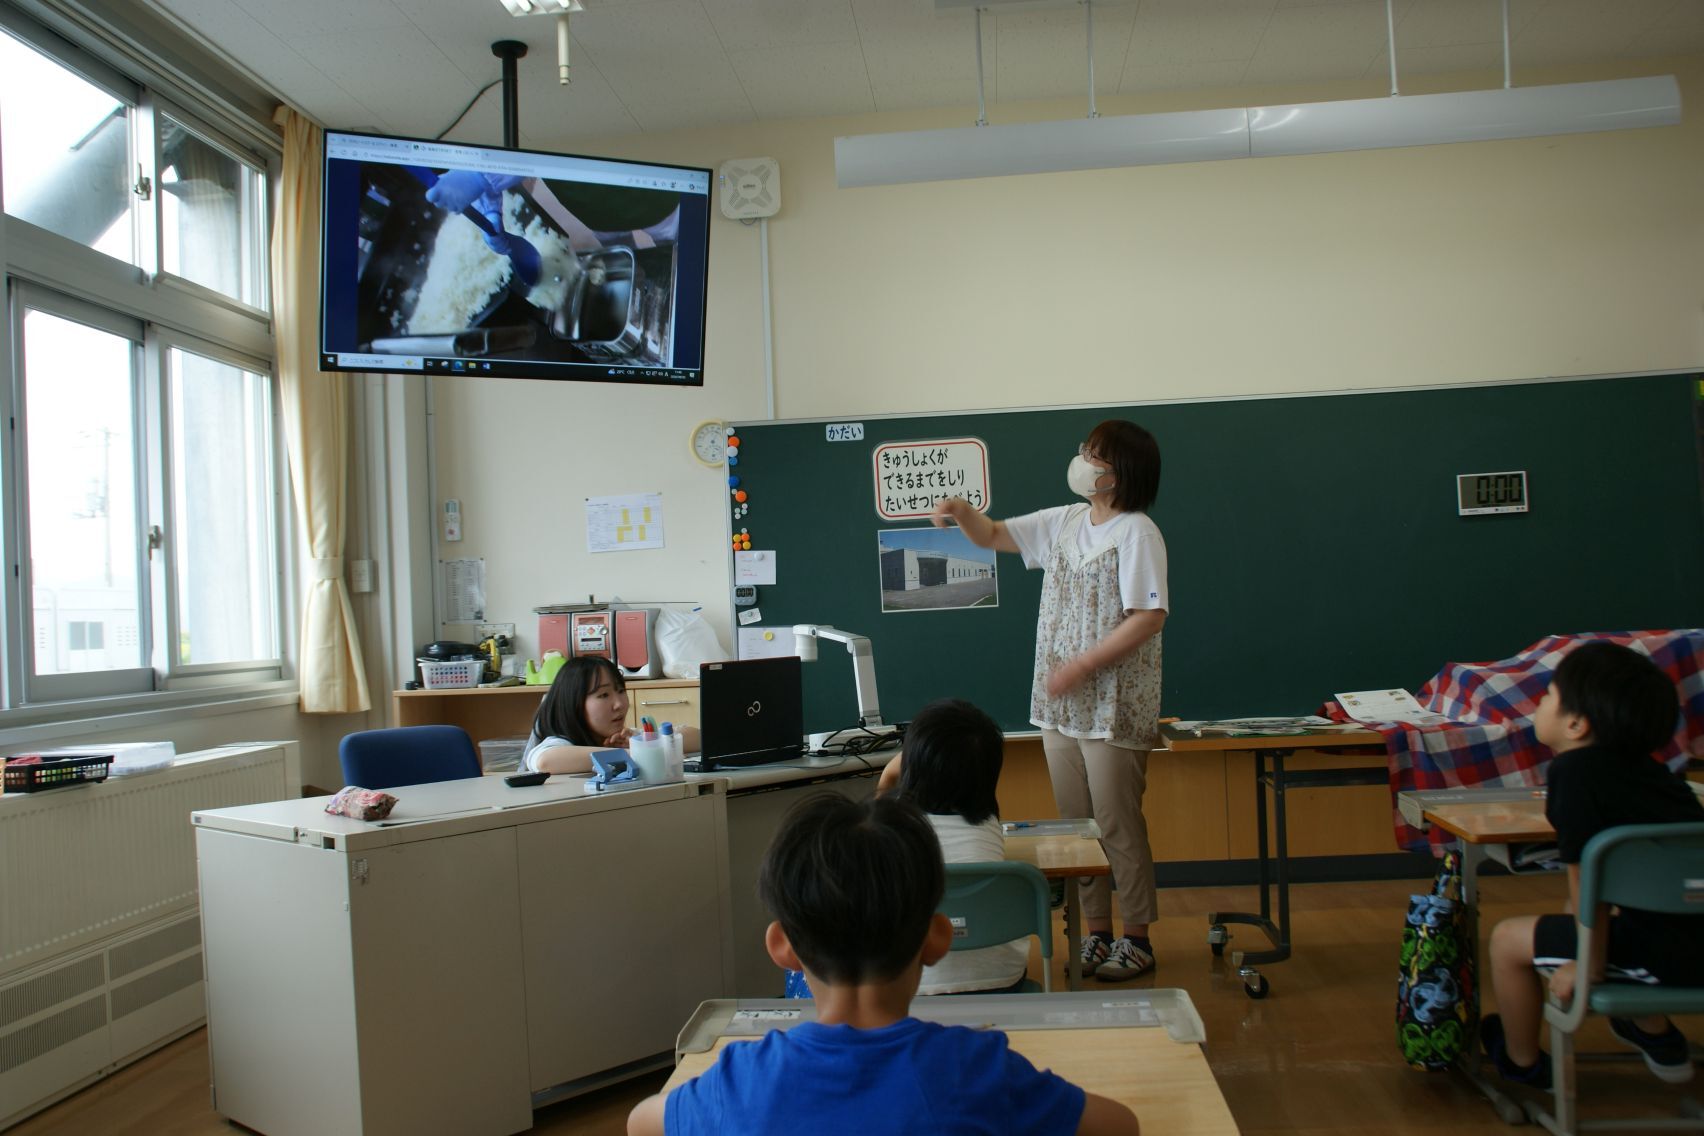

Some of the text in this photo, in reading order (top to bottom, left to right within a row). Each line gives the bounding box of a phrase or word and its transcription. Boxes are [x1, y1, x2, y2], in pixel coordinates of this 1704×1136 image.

[828, 425, 862, 440] かだい
[882, 448, 949, 469] きゅうしょくが
[883, 469, 965, 490] できるまでをしり
[885, 489, 982, 512] たいせつによう
